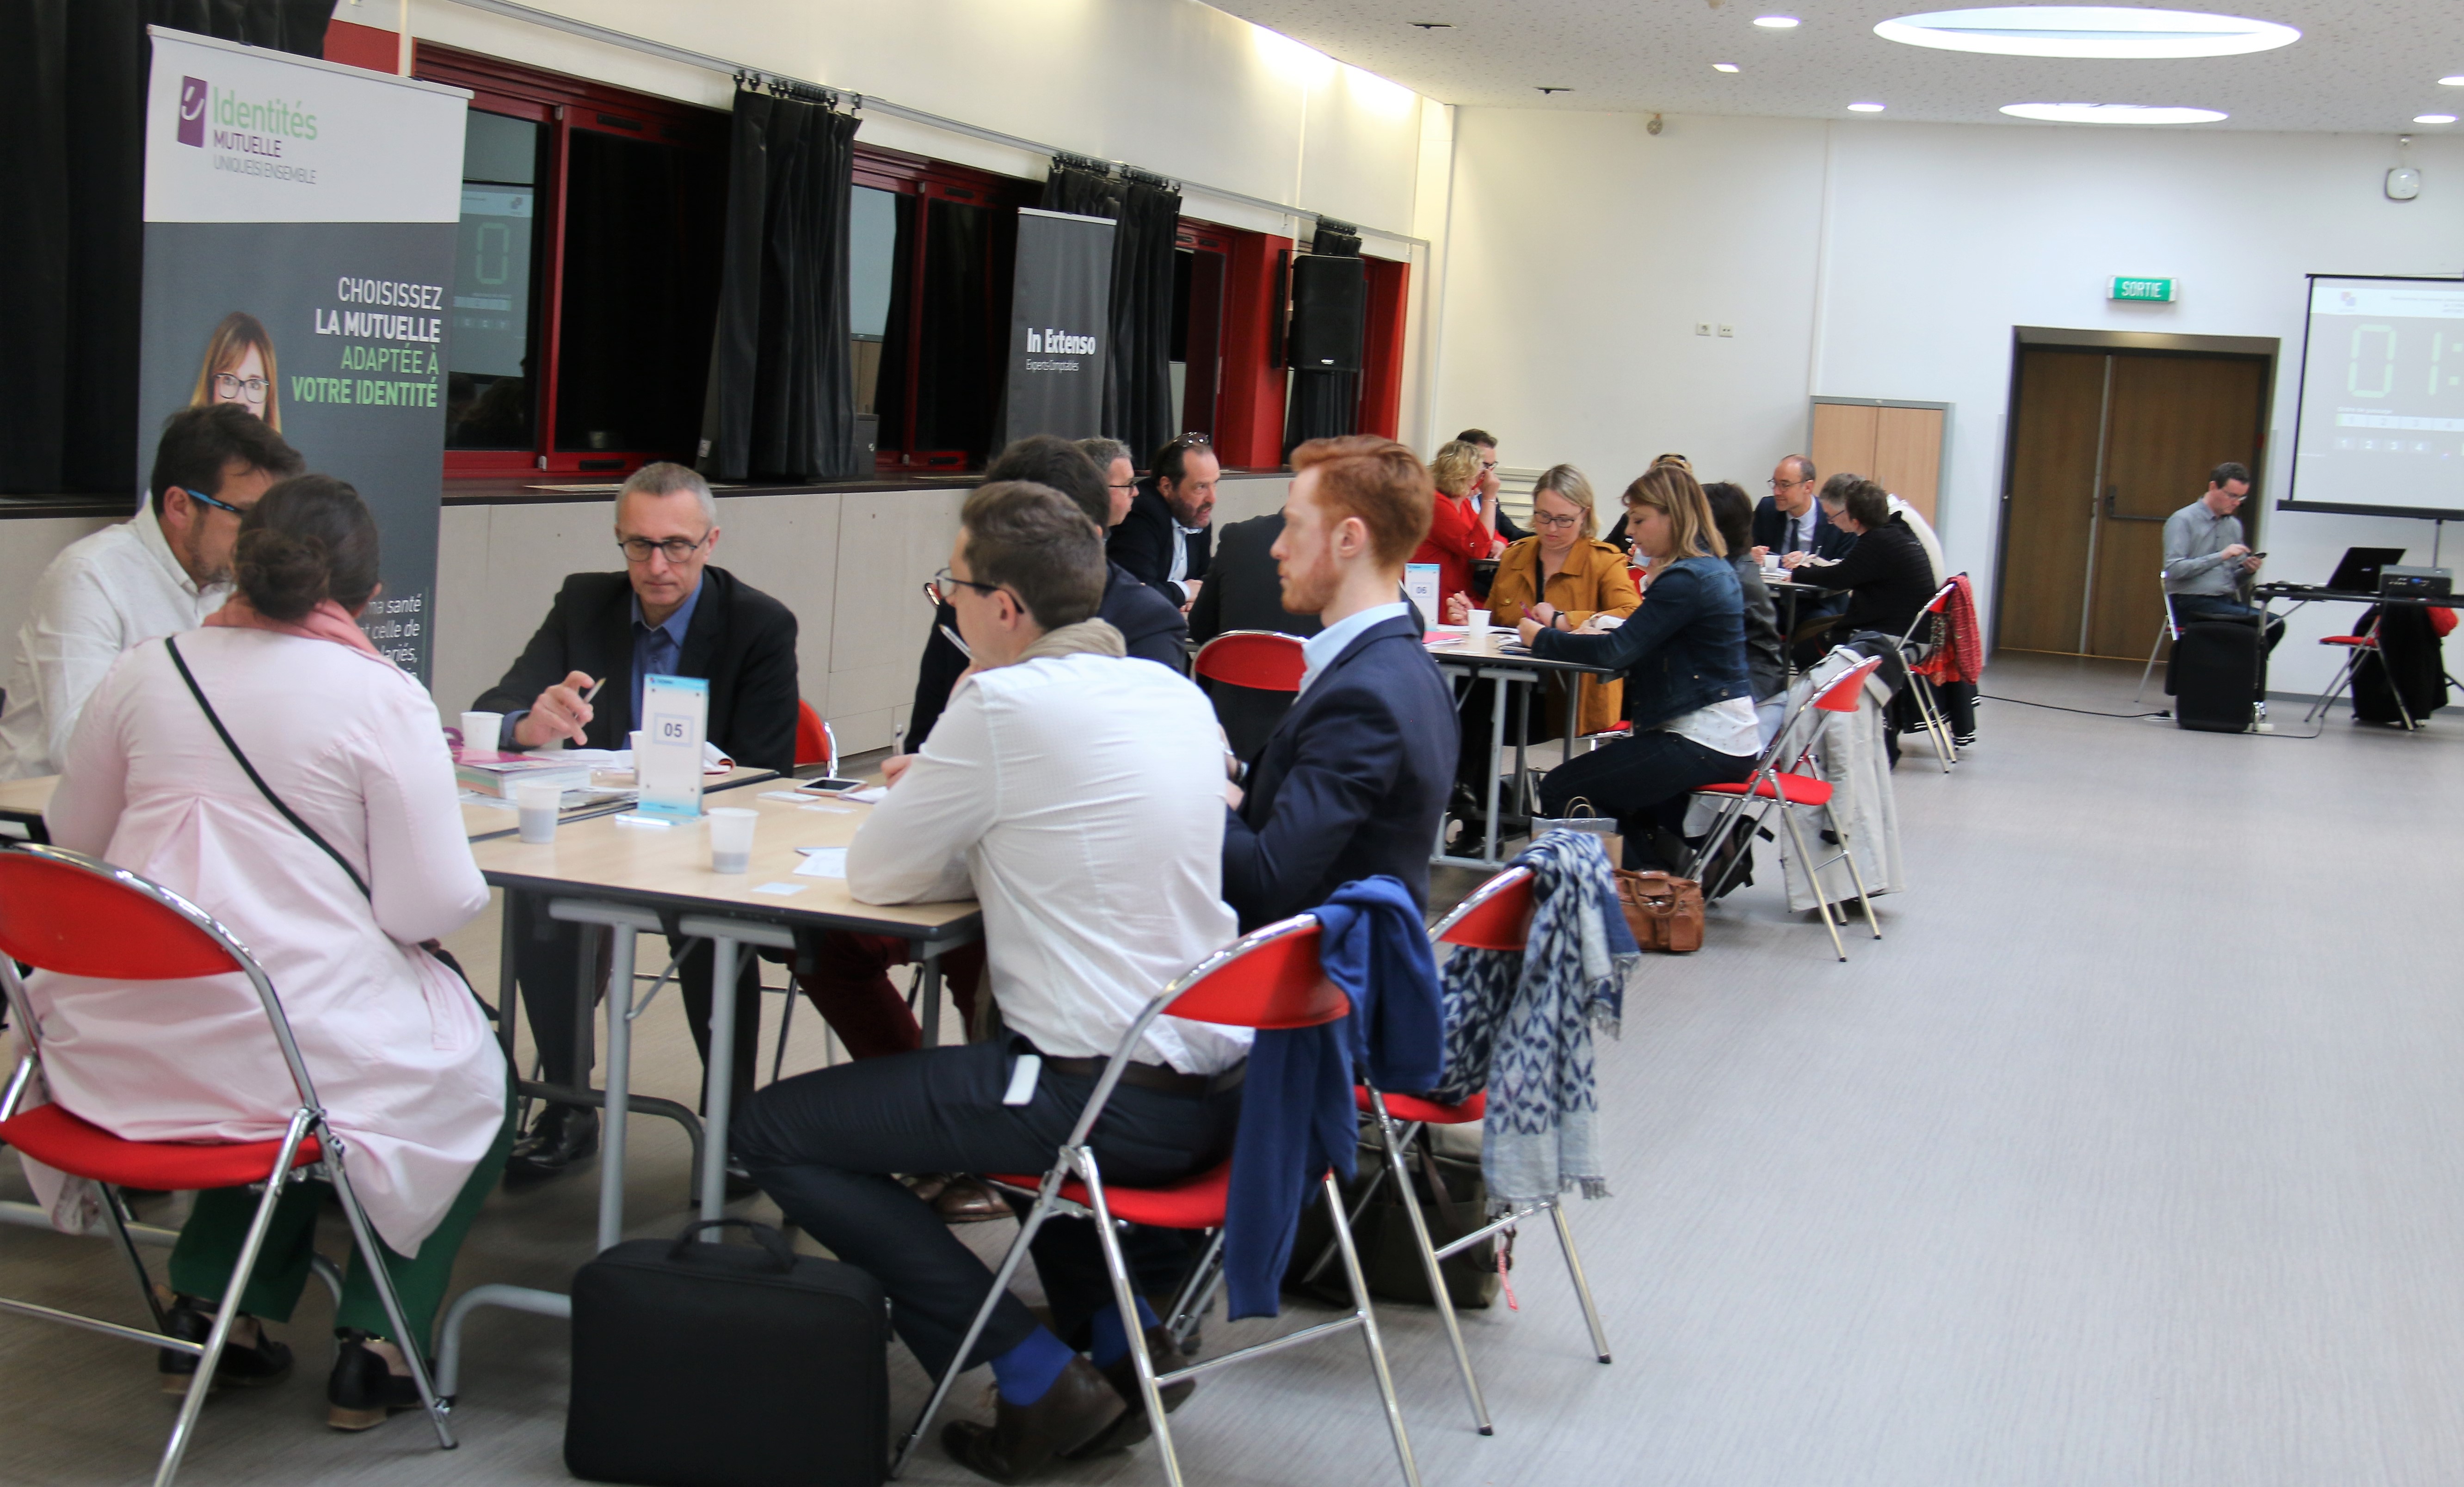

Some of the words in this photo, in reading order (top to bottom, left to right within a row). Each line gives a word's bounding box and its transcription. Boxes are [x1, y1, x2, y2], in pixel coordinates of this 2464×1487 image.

[213, 86, 317, 140] Identités
[214, 129, 282, 158] MUTUELLE
[265, 162, 316, 184] ENSEMBLE
[338, 277, 443, 310] CHOISISSEZ
[2122, 281, 2162, 297] SORTIE
[315, 308, 341, 336] LA
[344, 311, 442, 343] MUTUELLE
[1027, 327, 1041, 352] In
[1044, 328, 1096, 355] Extenso
[340, 343, 423, 374] ADAPTÉE
[426, 344, 439, 375] À
[291, 376, 352, 404] VOTRE
[356, 376, 438, 407] IDENTITÉ
[2365, 440, 2373, 449] 2
[387, 593, 422, 613] santé
[372, 620, 402, 639] celle
[404, 619, 420, 637] de
[665, 723, 683, 737] 05
